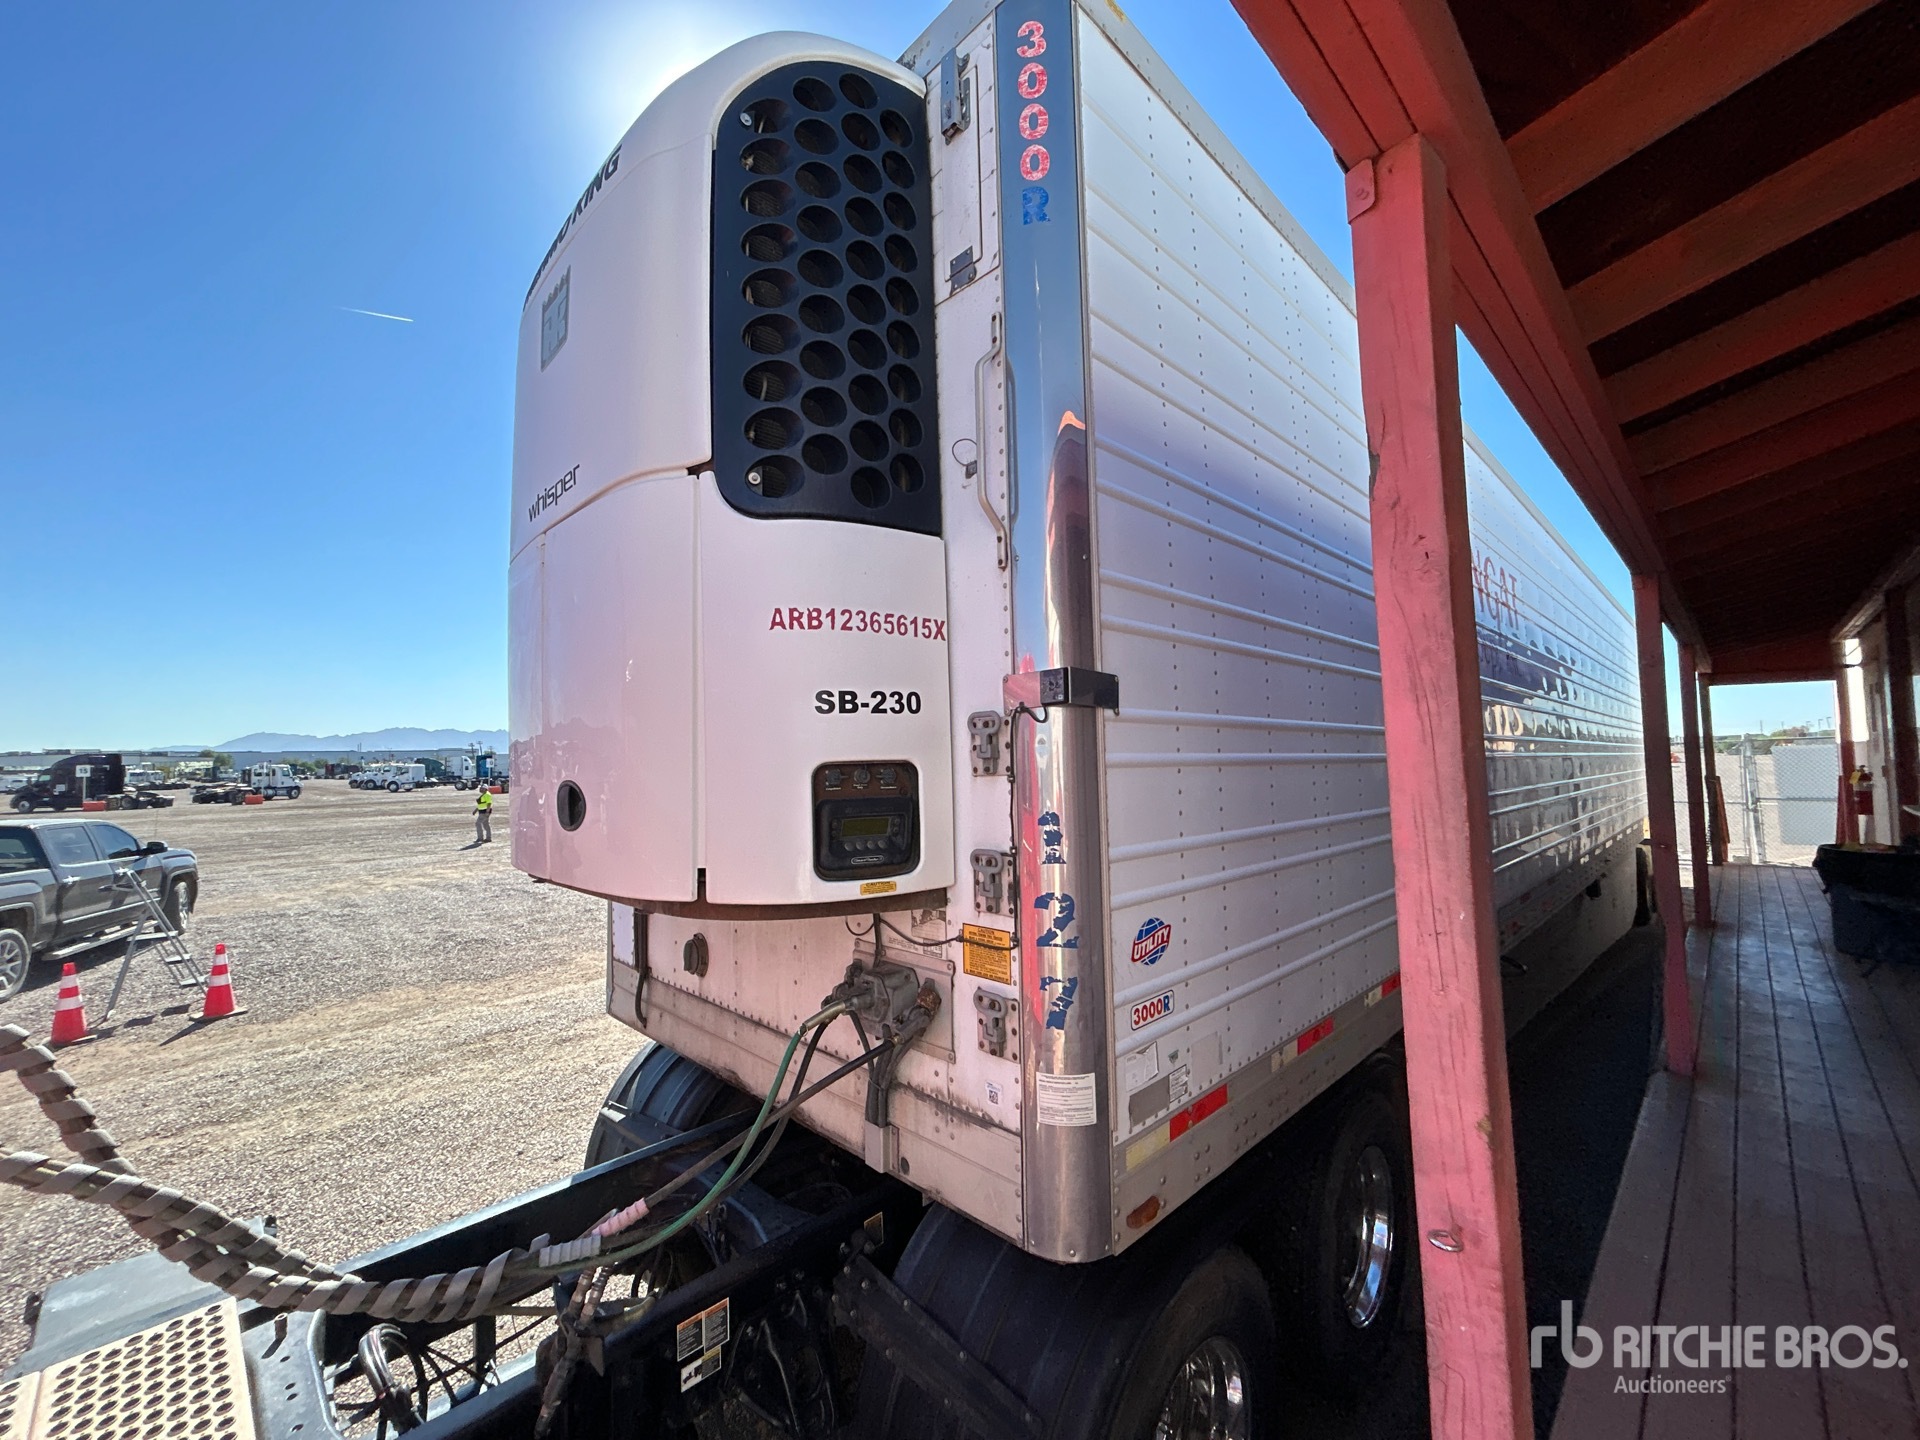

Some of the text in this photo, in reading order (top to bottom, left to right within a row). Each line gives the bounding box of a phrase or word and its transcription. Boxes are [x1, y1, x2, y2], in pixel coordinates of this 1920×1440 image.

[1016, 20, 1051, 226] 3000R
[528, 463, 580, 522] whisper
[769, 607, 946, 641] ARB12365615X
[814, 690, 921, 714] SB-230
[1133, 926, 1169, 960] UTILITY
[1133, 994, 1171, 1026] 3000R
